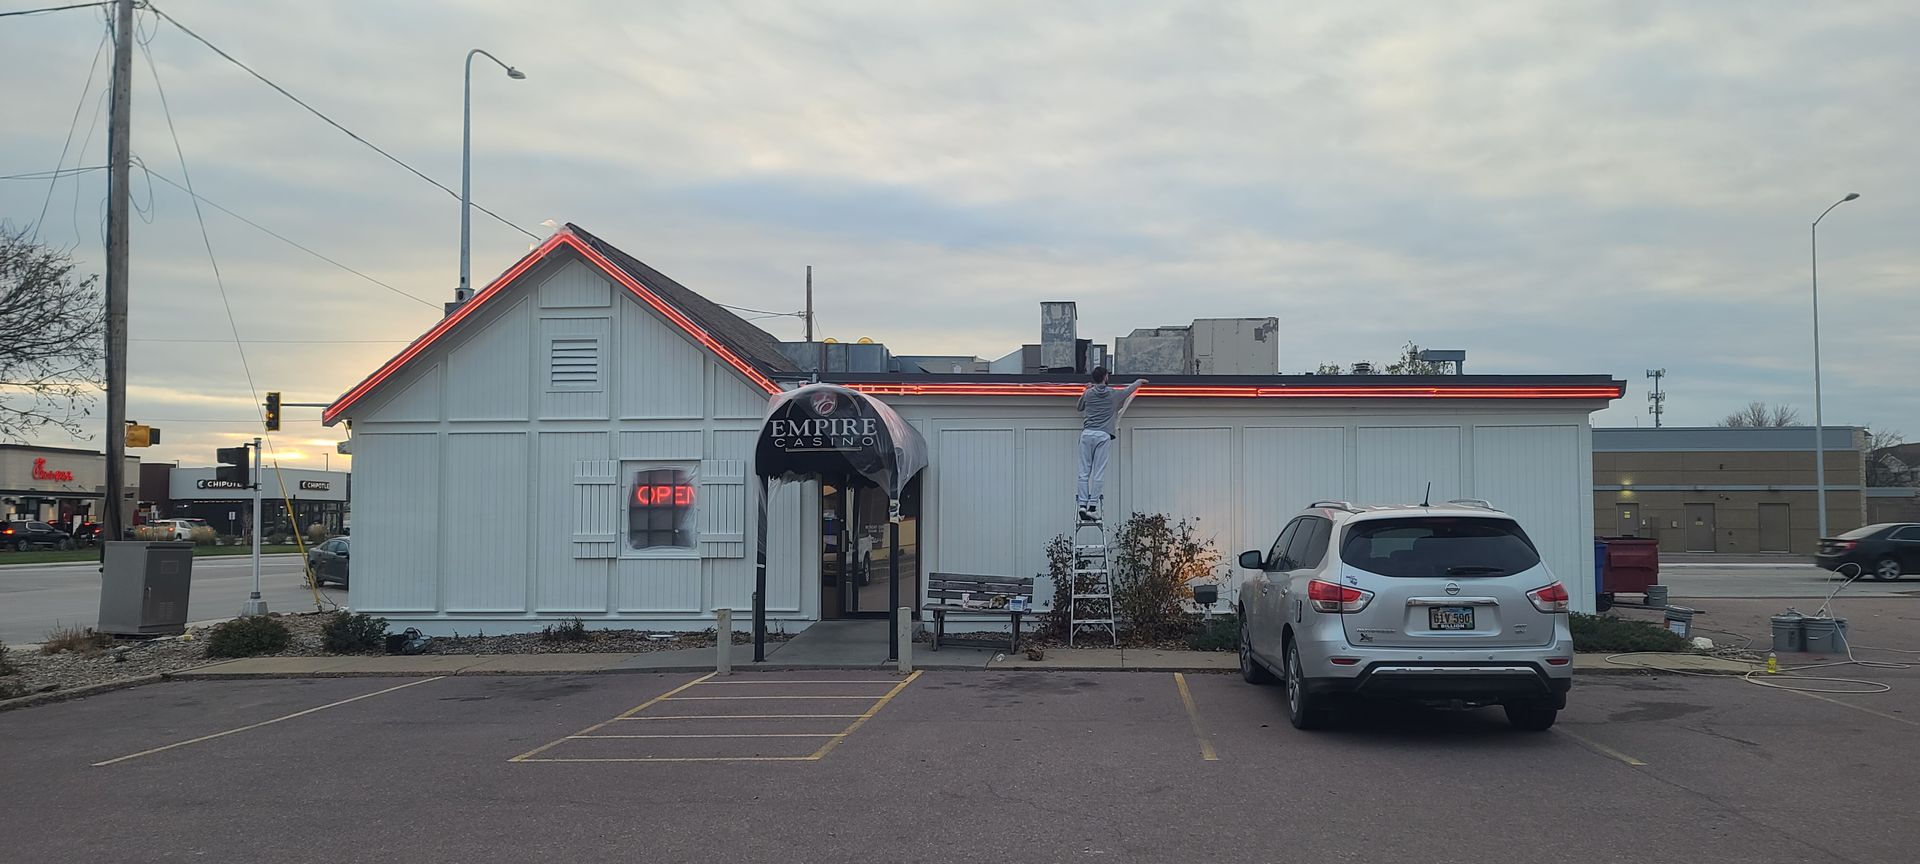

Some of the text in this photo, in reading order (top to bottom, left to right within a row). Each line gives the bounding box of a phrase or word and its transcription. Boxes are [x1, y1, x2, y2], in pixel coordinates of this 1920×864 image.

[770, 418, 877, 437] EMPIRE
[774, 437, 874, 448] CASINO
[637, 486, 696, 505] OPEN
